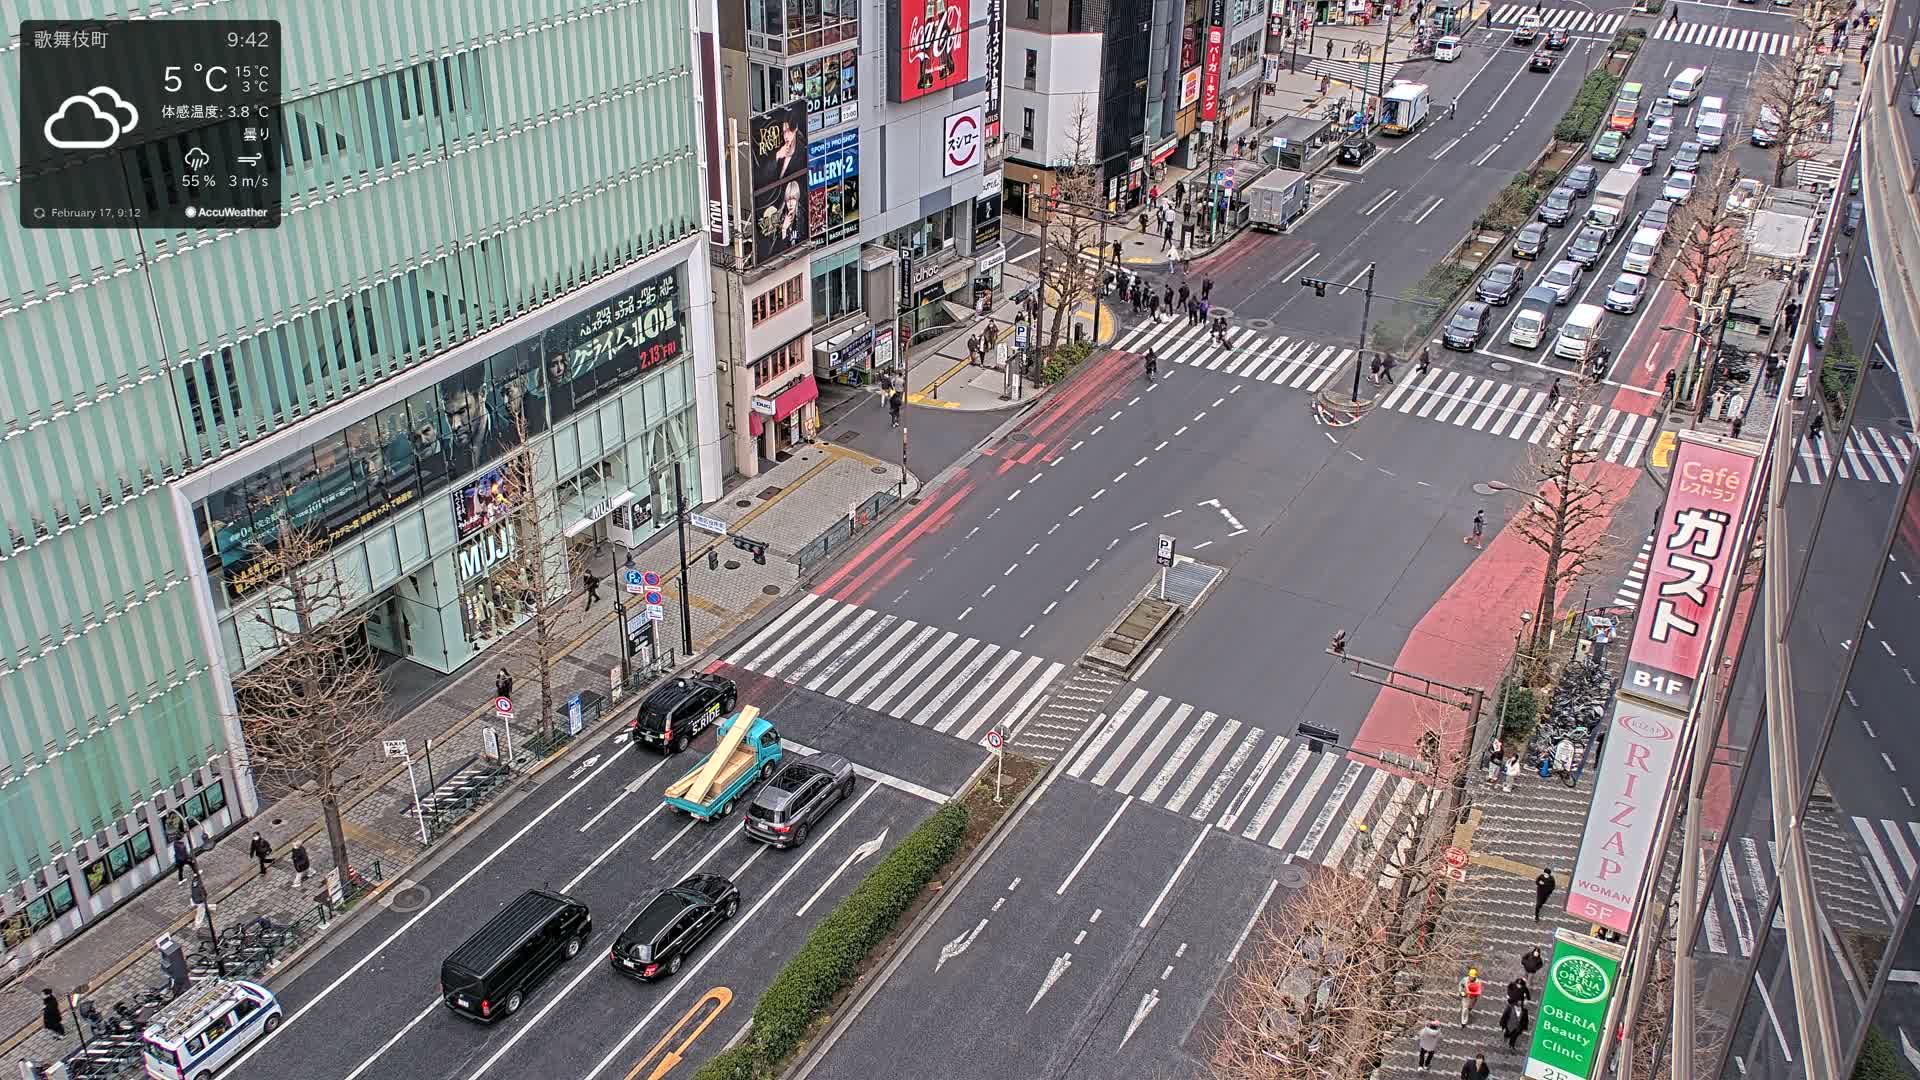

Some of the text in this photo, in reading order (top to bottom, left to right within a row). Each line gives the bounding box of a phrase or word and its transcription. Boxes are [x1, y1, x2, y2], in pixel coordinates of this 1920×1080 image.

[1205, 46, 1220, 111] バーガーキング
[824, 88, 853, 107] HALL
[810, 141, 831, 154] SPORS
[947, 134, 979, 151] スシロー
[710, 200, 723, 233] MUJI
[1017, 326, 1025, 336] P
[640, 341, 677, 369] 2.13 FRI
[1683, 461, 1740, 490] Café
[1680, 480, 1736, 502] レストラン
[591, 496, 615, 520] MUJI
[459, 522, 516, 581] MUJI
[1160, 539, 1169, 549] P
[1650, 507, 1731, 643] ガスト
[1632, 669, 1683, 695] B1F
[692, 706, 720, 736] S.RIDE
[1599, 742, 1653, 882] RIZAP
[1578, 879, 1631, 905] WOMAN
[1584, 902, 1613, 920] 5F
[1559, 970, 1600, 991] OBERIA
[1543, 1004, 1598, 1033] OBERIA
[1543, 1020, 1591, 1047] Beauty
[1542, 1039, 1584, 1063] Clinic
[1543, 1067, 1568, 1080] 2F
